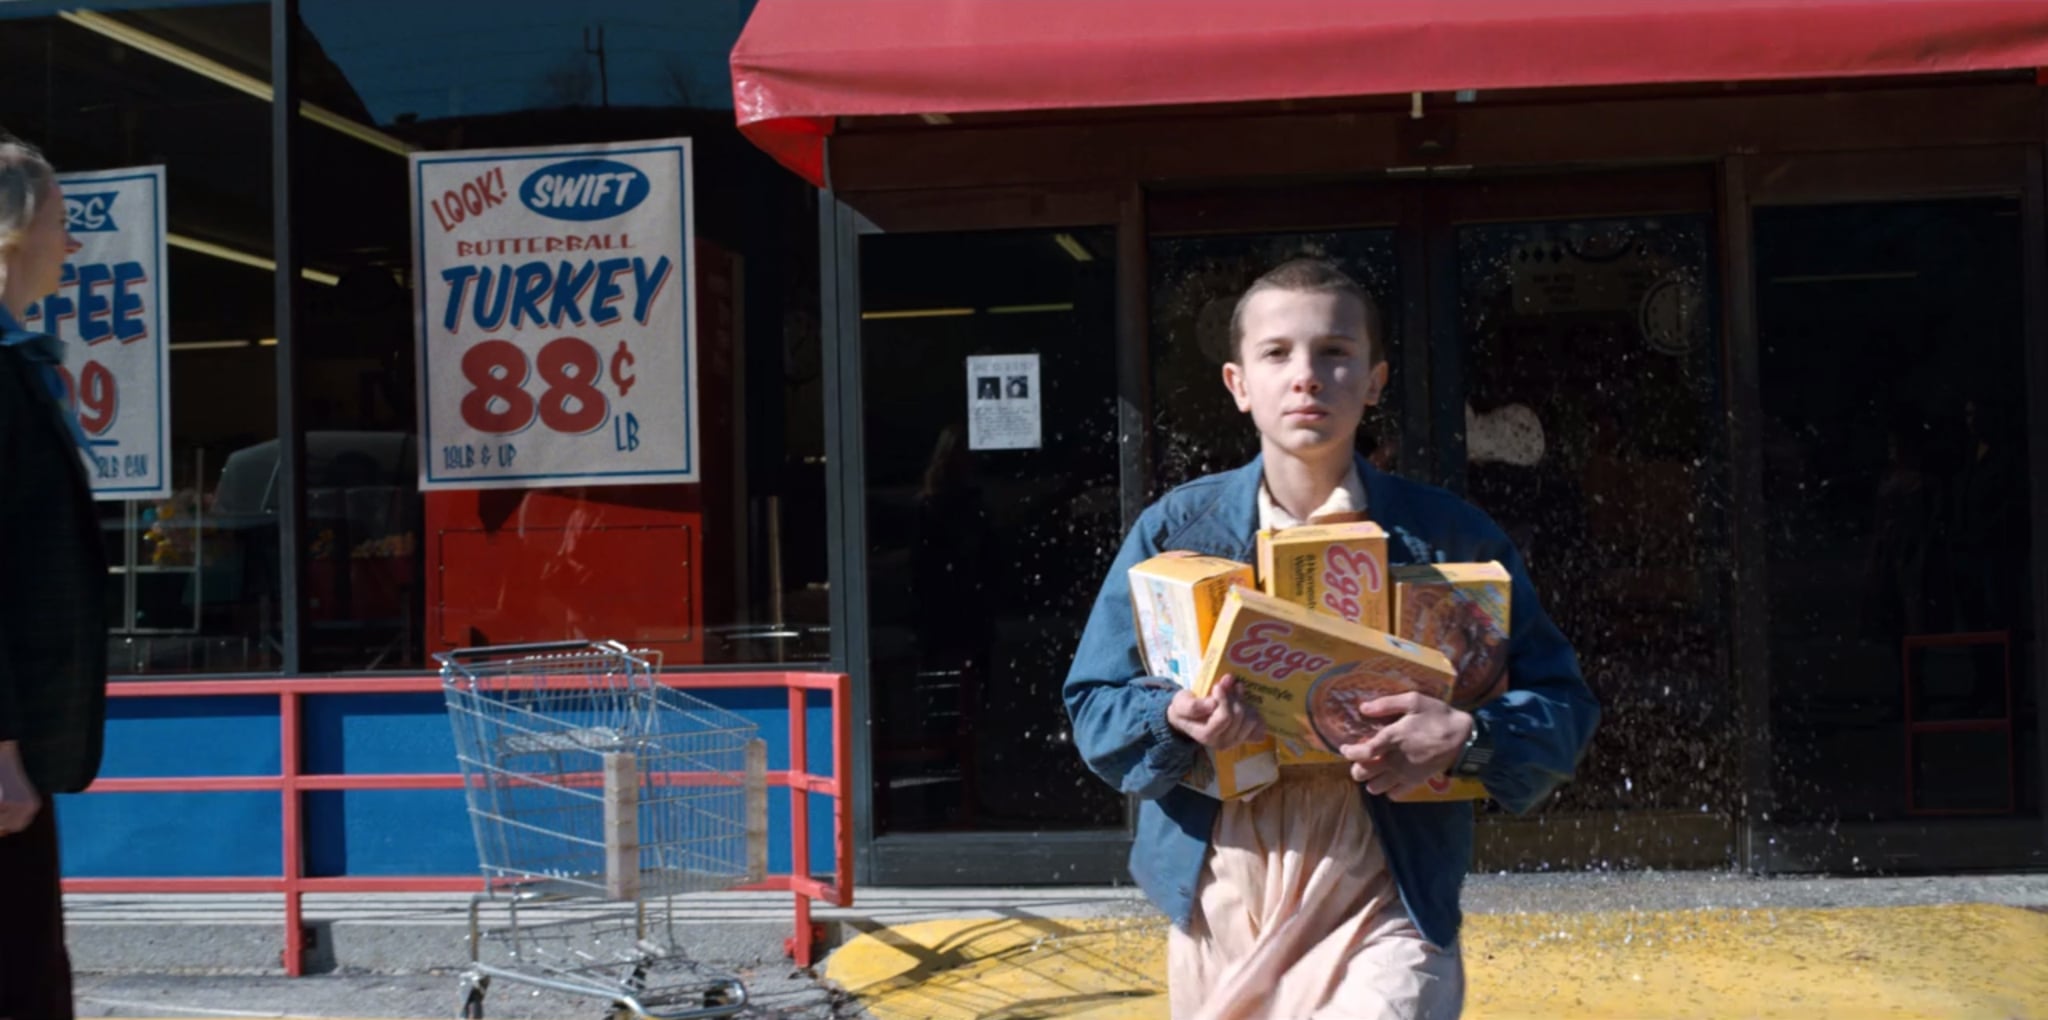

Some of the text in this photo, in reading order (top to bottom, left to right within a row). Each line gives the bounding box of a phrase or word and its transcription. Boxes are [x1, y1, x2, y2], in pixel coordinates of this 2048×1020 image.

[431, 167, 507, 232] LOOK!
[530, 172, 646, 208] SWIFT
[457, 234, 636, 257] BUTTERBALL
[441, 255, 672, 334] TURKEY
[615, 411, 640, 452] LB
[123, 453, 148, 478] CAN
[481, 444, 493, 468] &
[498, 442, 518, 467] UP
[1324, 544, 1381, 624] Egg
[1228, 622, 1333, 681] Eggo
